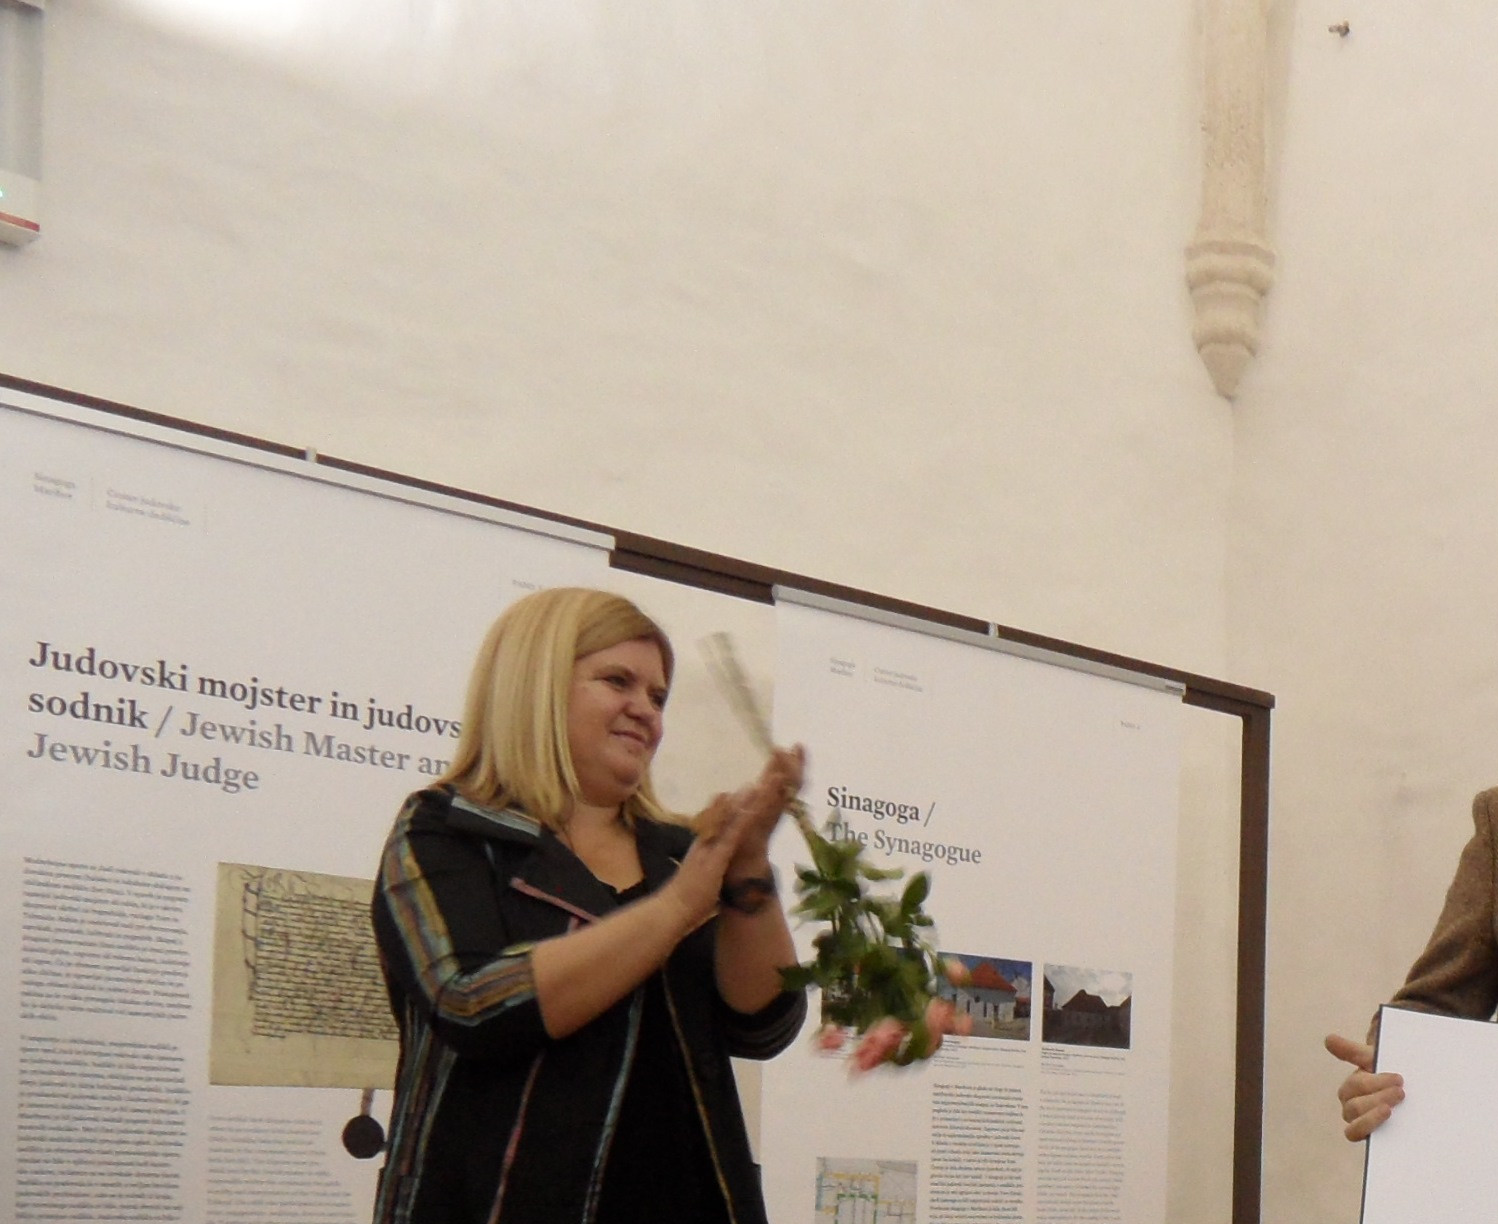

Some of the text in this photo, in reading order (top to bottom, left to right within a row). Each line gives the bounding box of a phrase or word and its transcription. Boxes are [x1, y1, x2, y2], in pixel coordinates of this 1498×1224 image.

[28, 641, 188, 692] Judovski
[198, 676, 323, 714] mojster
[329, 691, 360, 722] in
[28, 691, 149, 729] sodnik
[154, 705, 173, 738] /
[180, 712, 295, 753] Jewish
[303, 731, 411, 771] Master
[27, 732, 259, 794] Jewish Judge
[827, 786, 936, 828] Sinagoga /
[827, 821, 982, 866] The Synagogue
